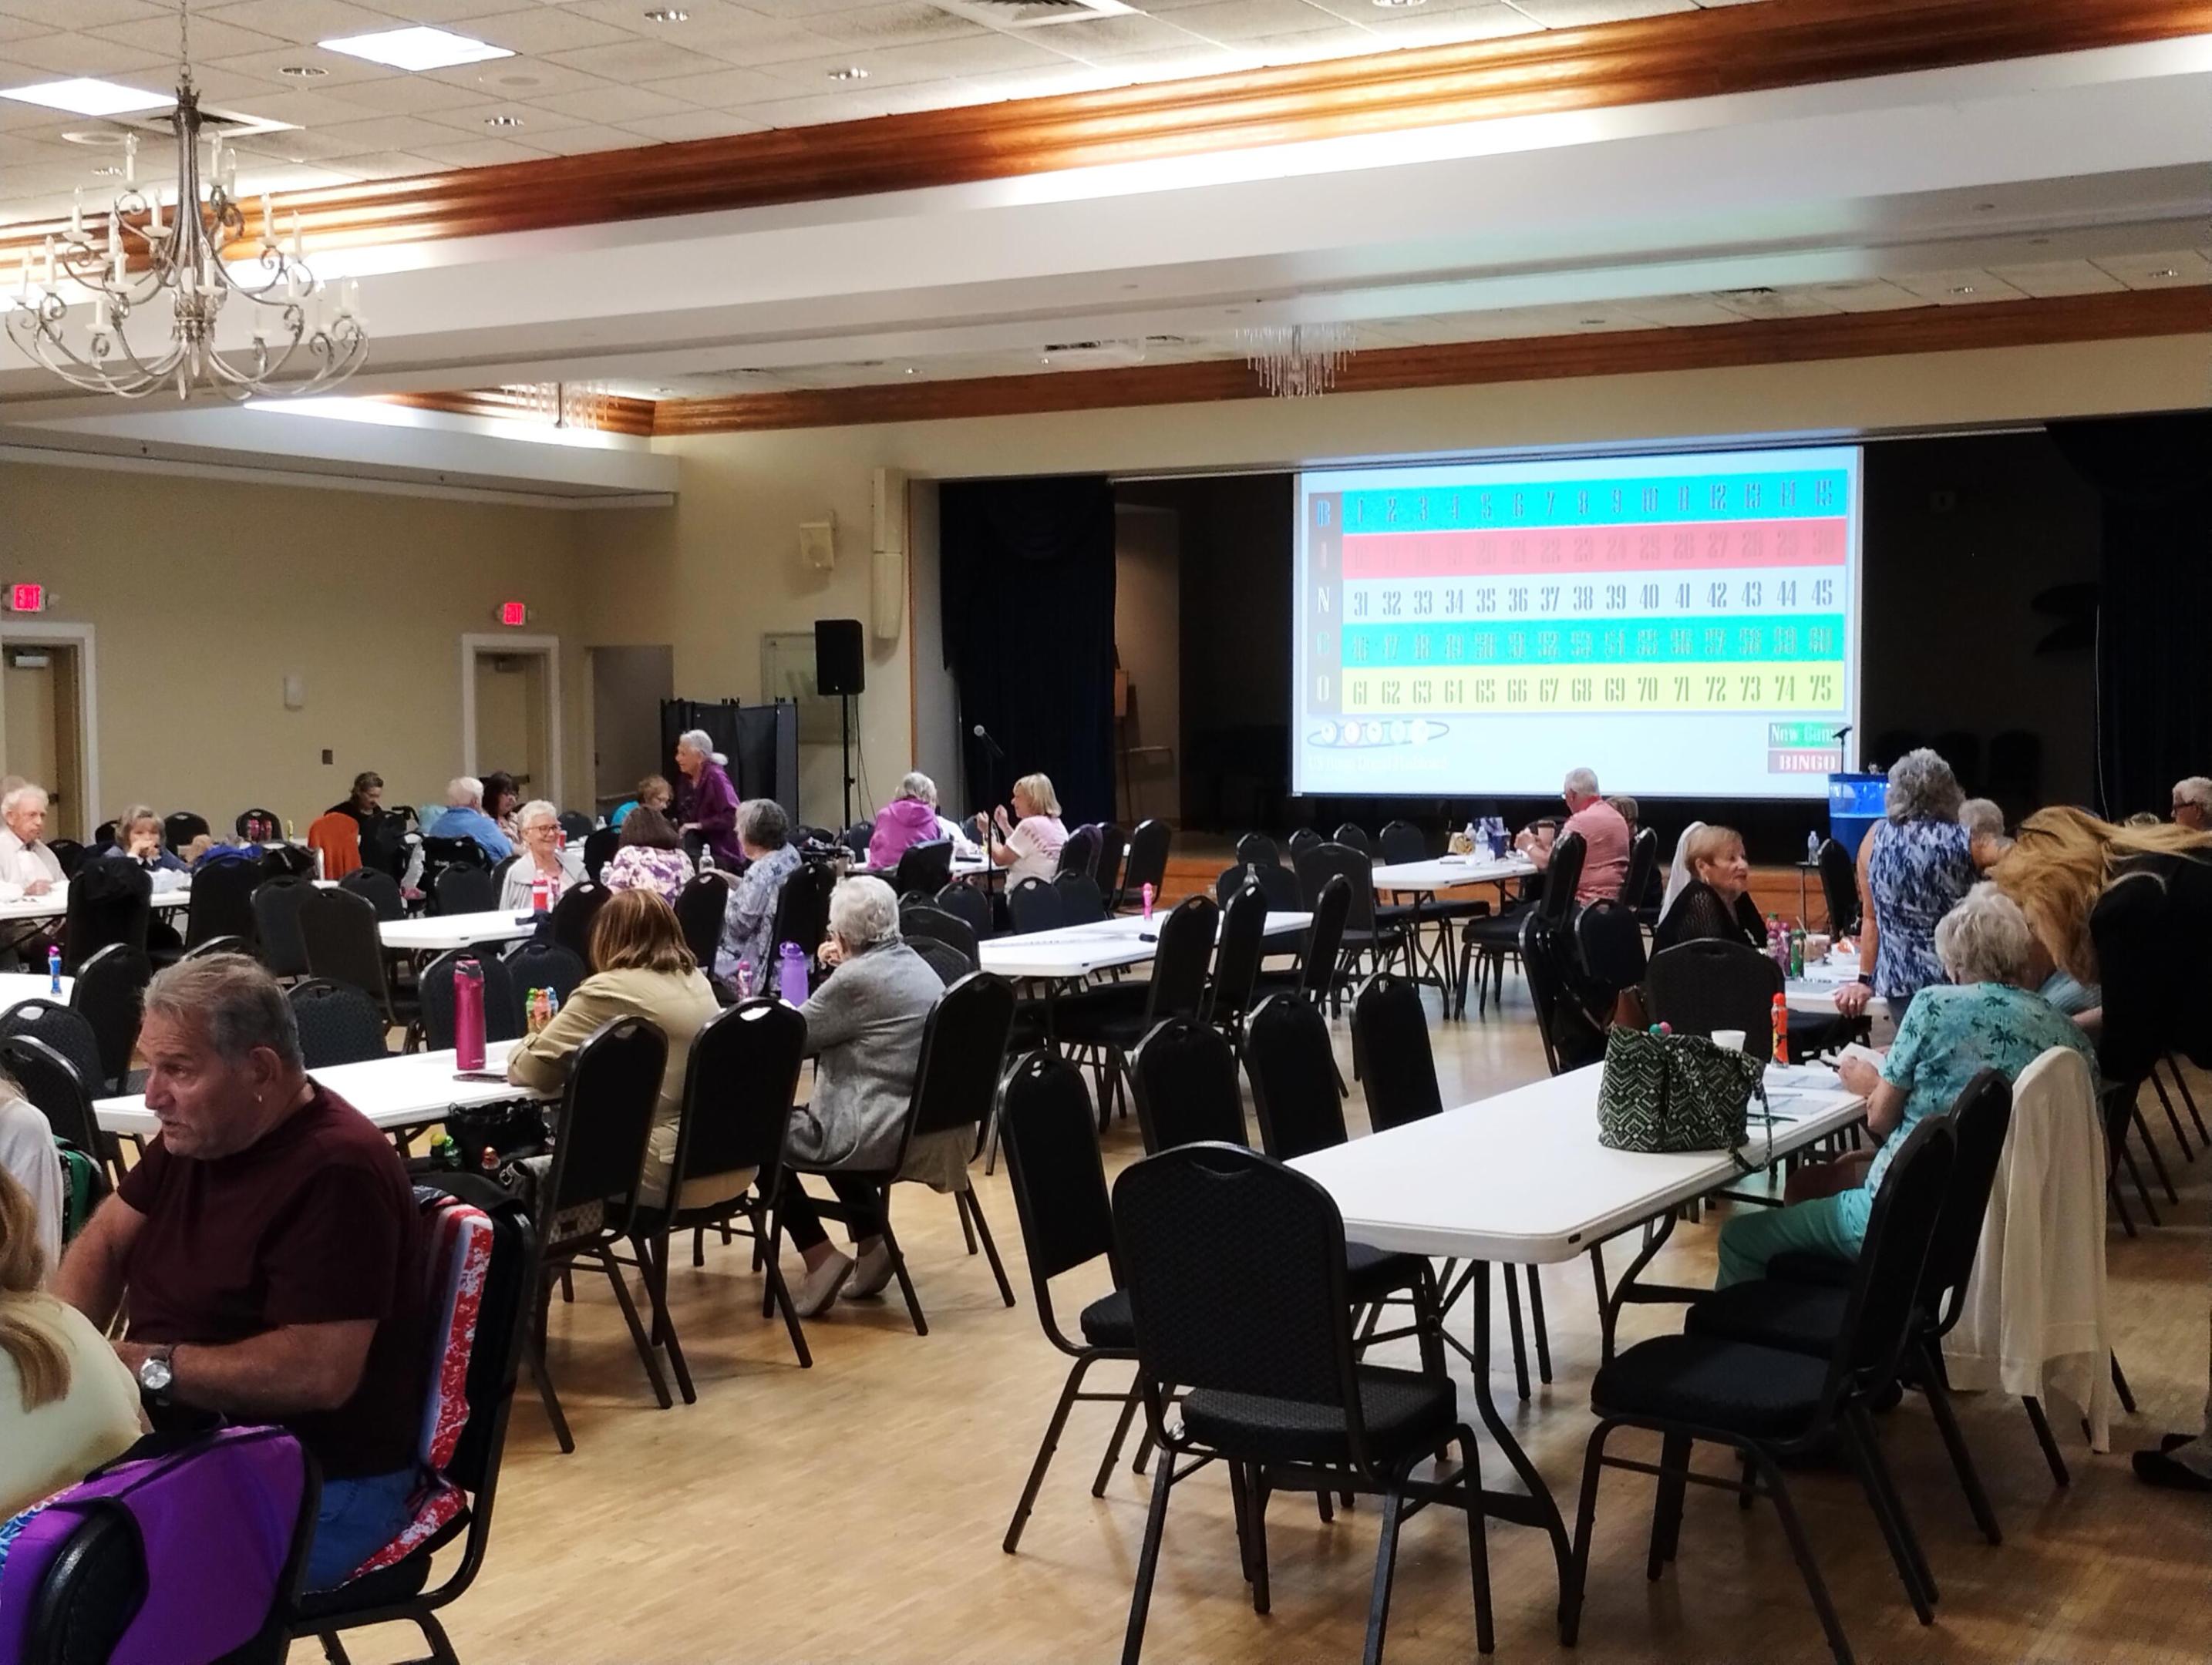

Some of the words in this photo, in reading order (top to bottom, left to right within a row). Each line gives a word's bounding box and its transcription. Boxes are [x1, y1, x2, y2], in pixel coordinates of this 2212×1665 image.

[1389, 498, 1397, 523] 2
[1419, 497, 1428, 521] 3
[1451, 493, 1459, 520] 4
[1482, 493, 1491, 519] 5
[1514, 493, 1523, 518] 6
[1547, 491, 1554, 516] 7
[1579, 490, 1588, 515] 8
[1612, 489, 1621, 513] 9
[1642, 487, 1658, 513] 10
[1678, 486, 1689, 511] 11
[1710, 484, 1725, 510] 12
[1745, 483, 1761, 509] 13
[1780, 481, 1795, 507] 14
[1815, 479, 1832, 506] 15
[1574, 536, 1594, 562] 23
[1607, 534, 1627, 561] 24
[1639, 533, 1661, 560] 25
[1673, 532, 1695, 559] 26
[1708, 530, 1729, 558] 27
[1318, 587, 1330, 613] N
[1354, 591, 1368, 616] 31
[1382, 590, 1401, 615] 32
[1414, 590, 1433, 615] 33
[1446, 589, 1463, 614] 34
[1476, 588, 1496, 613] 35
[1509, 587, 1527, 612] 36
[1541, 586, 1560, 612] 37
[1574, 586, 1593, 610] 38
[1607, 584, 1626, 610] 39
[1640, 584, 1658, 609] 40
[1675, 583, 1690, 608] 41
[1707, 582, 1726, 608] 42
[1742, 581, 1761, 607] 43
[1777, 580, 1796, 607] 44
[1812, 580, 1832, 606] 45
[1353, 681, 1367, 705] 61
[1382, 681, 1400, 705] 62
[1413, 680, 1432, 704] 63
[1445, 680, 1463, 704] 64
[1476, 679, 1496, 703] 65
[1507, 679, 1527, 703] 66
[1540, 678, 1559, 702] 67
[1572, 678, 1591, 702] 68
[1605, 677, 1624, 702] 69
[1638, 677, 1658, 702] 70
[1675, 676, 1689, 702] 71
[1706, 676, 1725, 701] 72
[1740, 675, 1760, 701] 73
[1775, 675, 1794, 701] 74
[1810, 674, 1831, 701] 75
[1772, 725, 1798, 742] New
[1779, 755, 1835, 770] BINGO
